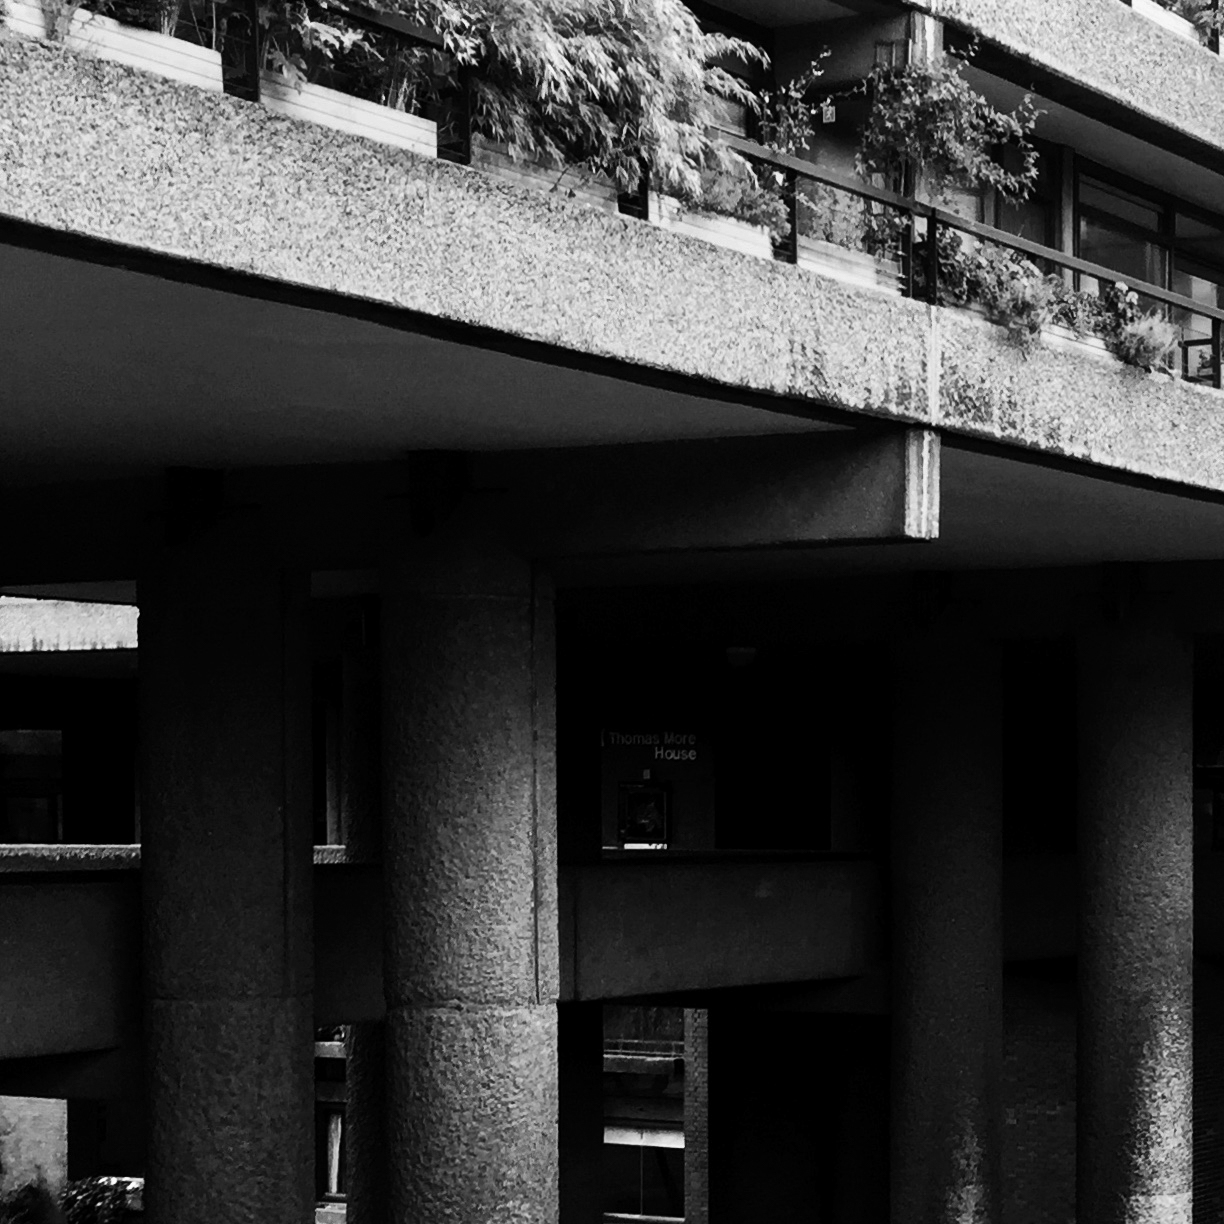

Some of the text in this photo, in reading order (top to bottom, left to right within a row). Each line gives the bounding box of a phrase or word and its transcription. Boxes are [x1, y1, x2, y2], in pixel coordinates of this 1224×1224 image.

[608, 731, 697, 745] Thomas More
[654, 746, 698, 760] House
